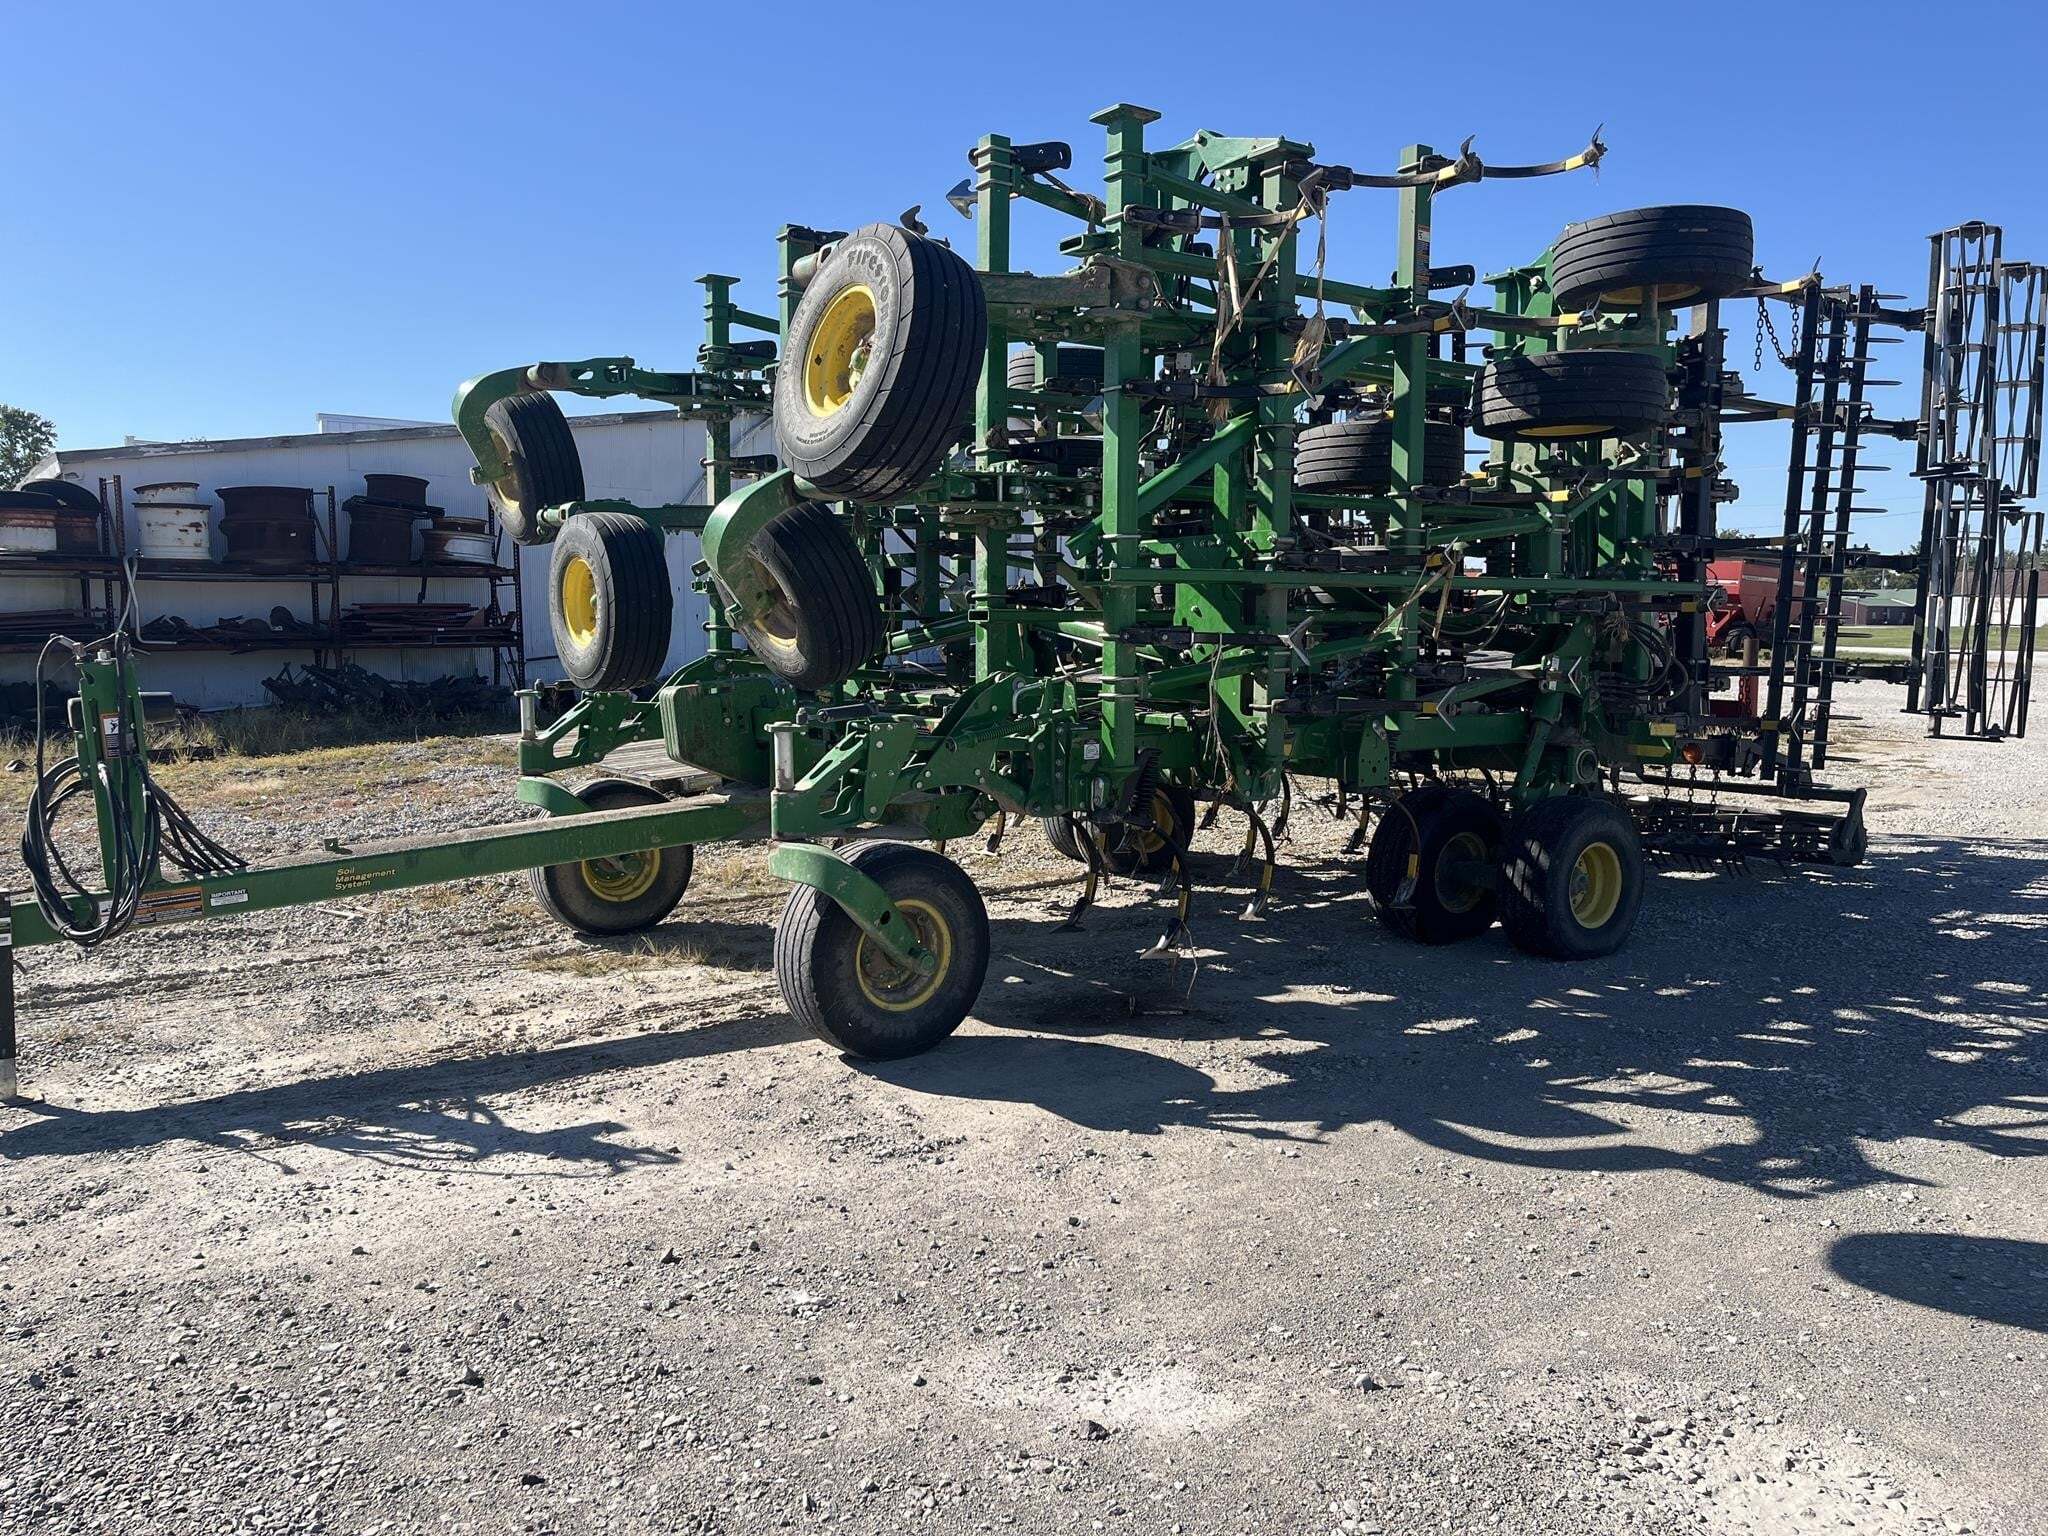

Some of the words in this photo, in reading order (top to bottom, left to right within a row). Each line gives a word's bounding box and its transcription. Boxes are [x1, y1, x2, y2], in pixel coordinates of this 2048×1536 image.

[846, 248, 890, 342] Firestone
[335, 869, 396, 884] Management
[337, 867, 355, 876] Soil
[335, 880, 371, 891] System
[211, 889, 247, 898] IMPORTANT
